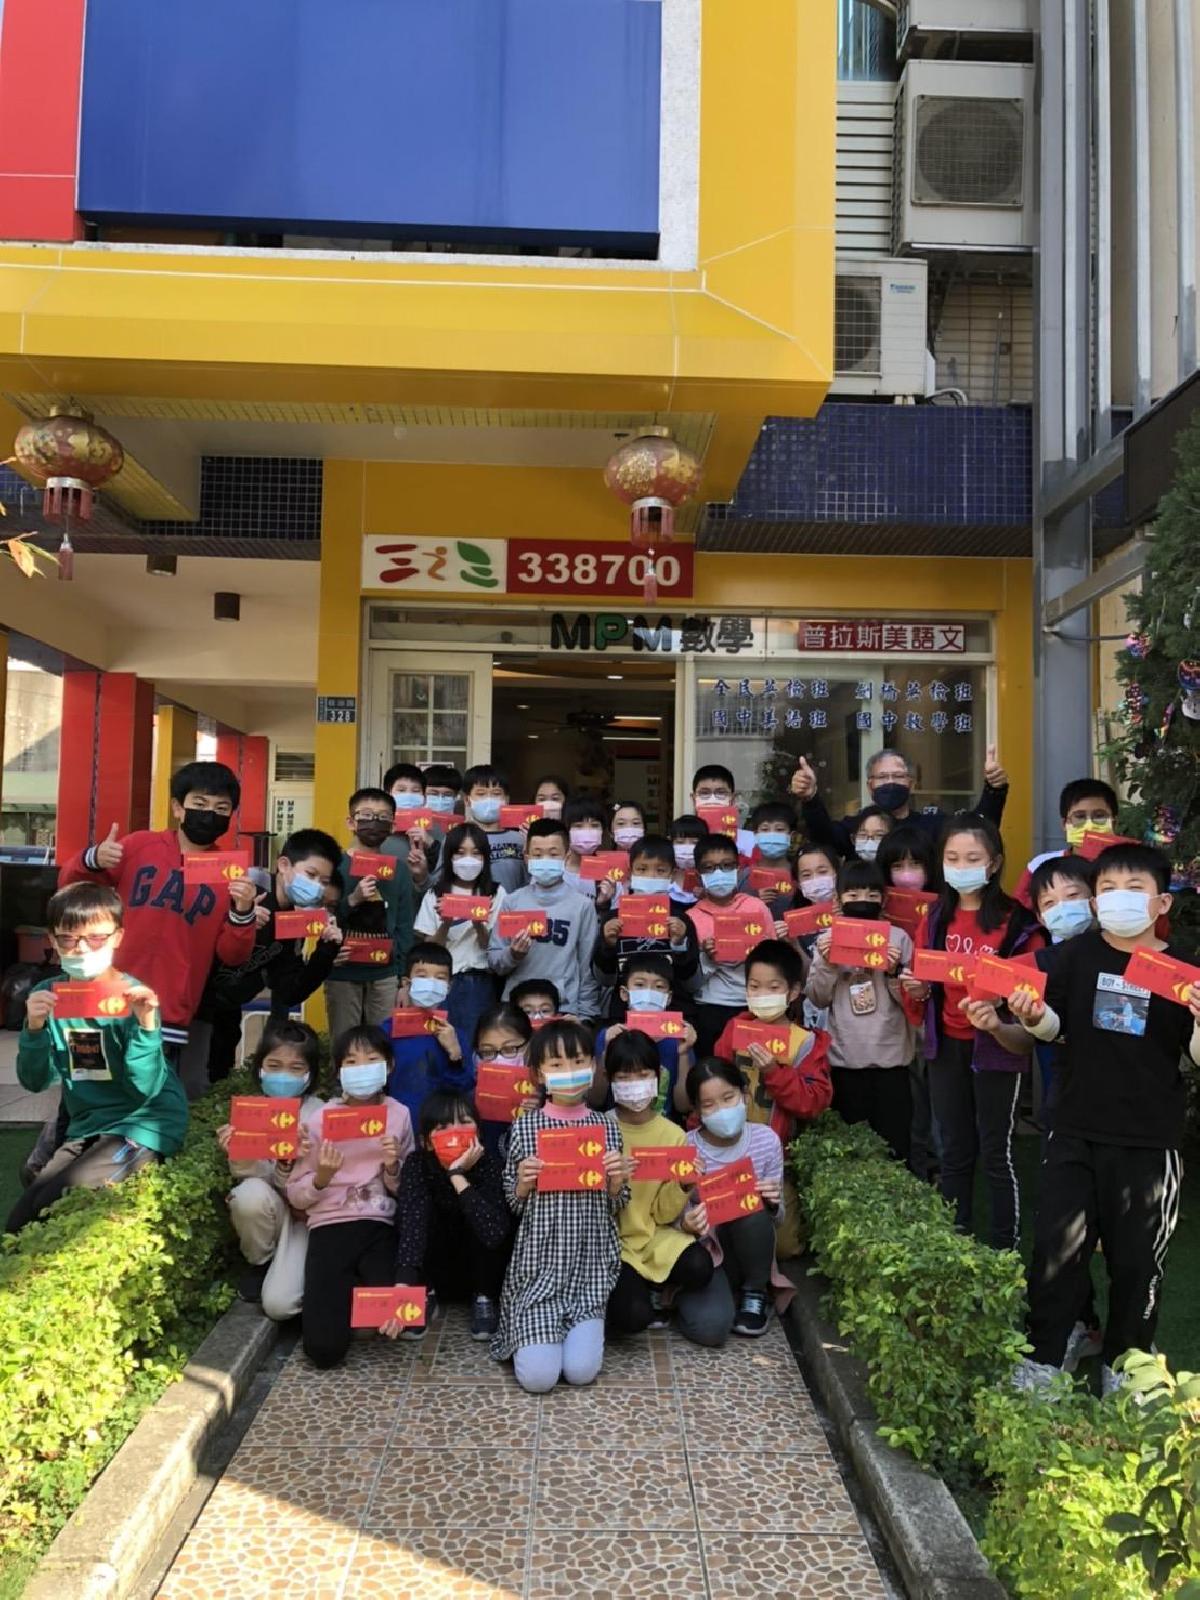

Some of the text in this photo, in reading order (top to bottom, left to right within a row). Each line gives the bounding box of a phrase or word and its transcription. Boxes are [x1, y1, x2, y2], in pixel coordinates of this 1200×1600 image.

[517, 552, 681, 587] 338700
[803, 624, 963, 650] 普拉斯美語文
[128, 865, 217, 926] GAP
